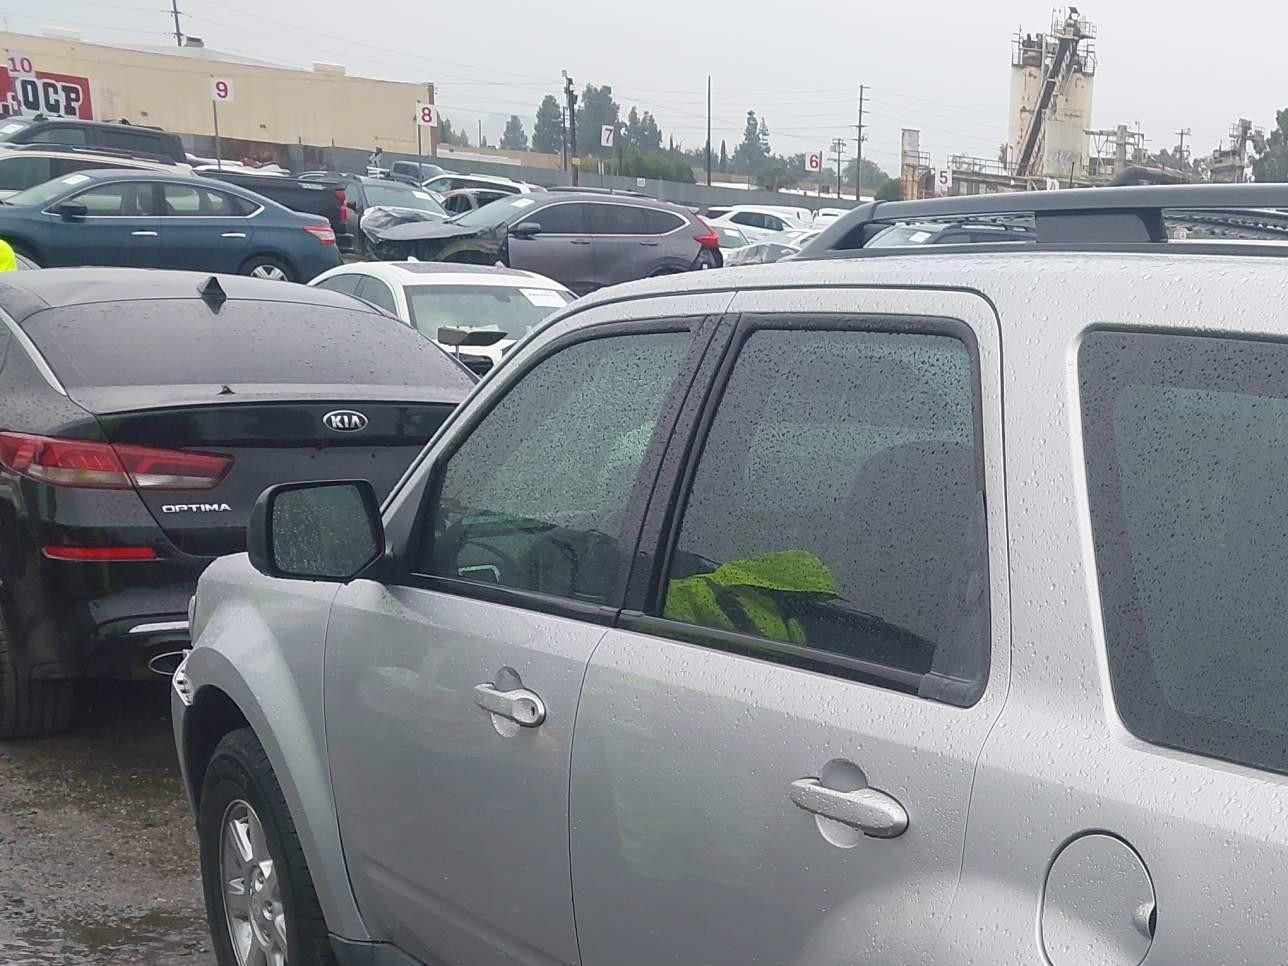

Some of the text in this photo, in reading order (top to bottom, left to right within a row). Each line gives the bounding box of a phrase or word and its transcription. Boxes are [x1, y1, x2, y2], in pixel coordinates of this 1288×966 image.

[8, 57, 33, 73] 10
[20, 79, 81, 116] OCP
[215, 81, 229, 98] 9
[421, 106, 432, 123] 8
[604, 128, 614, 144] 7
[809, 154, 819, 169] 6
[939, 170, 949, 185] 5
[330, 414, 362, 429] KIA
[161, 503, 233, 513] OPTIMA
